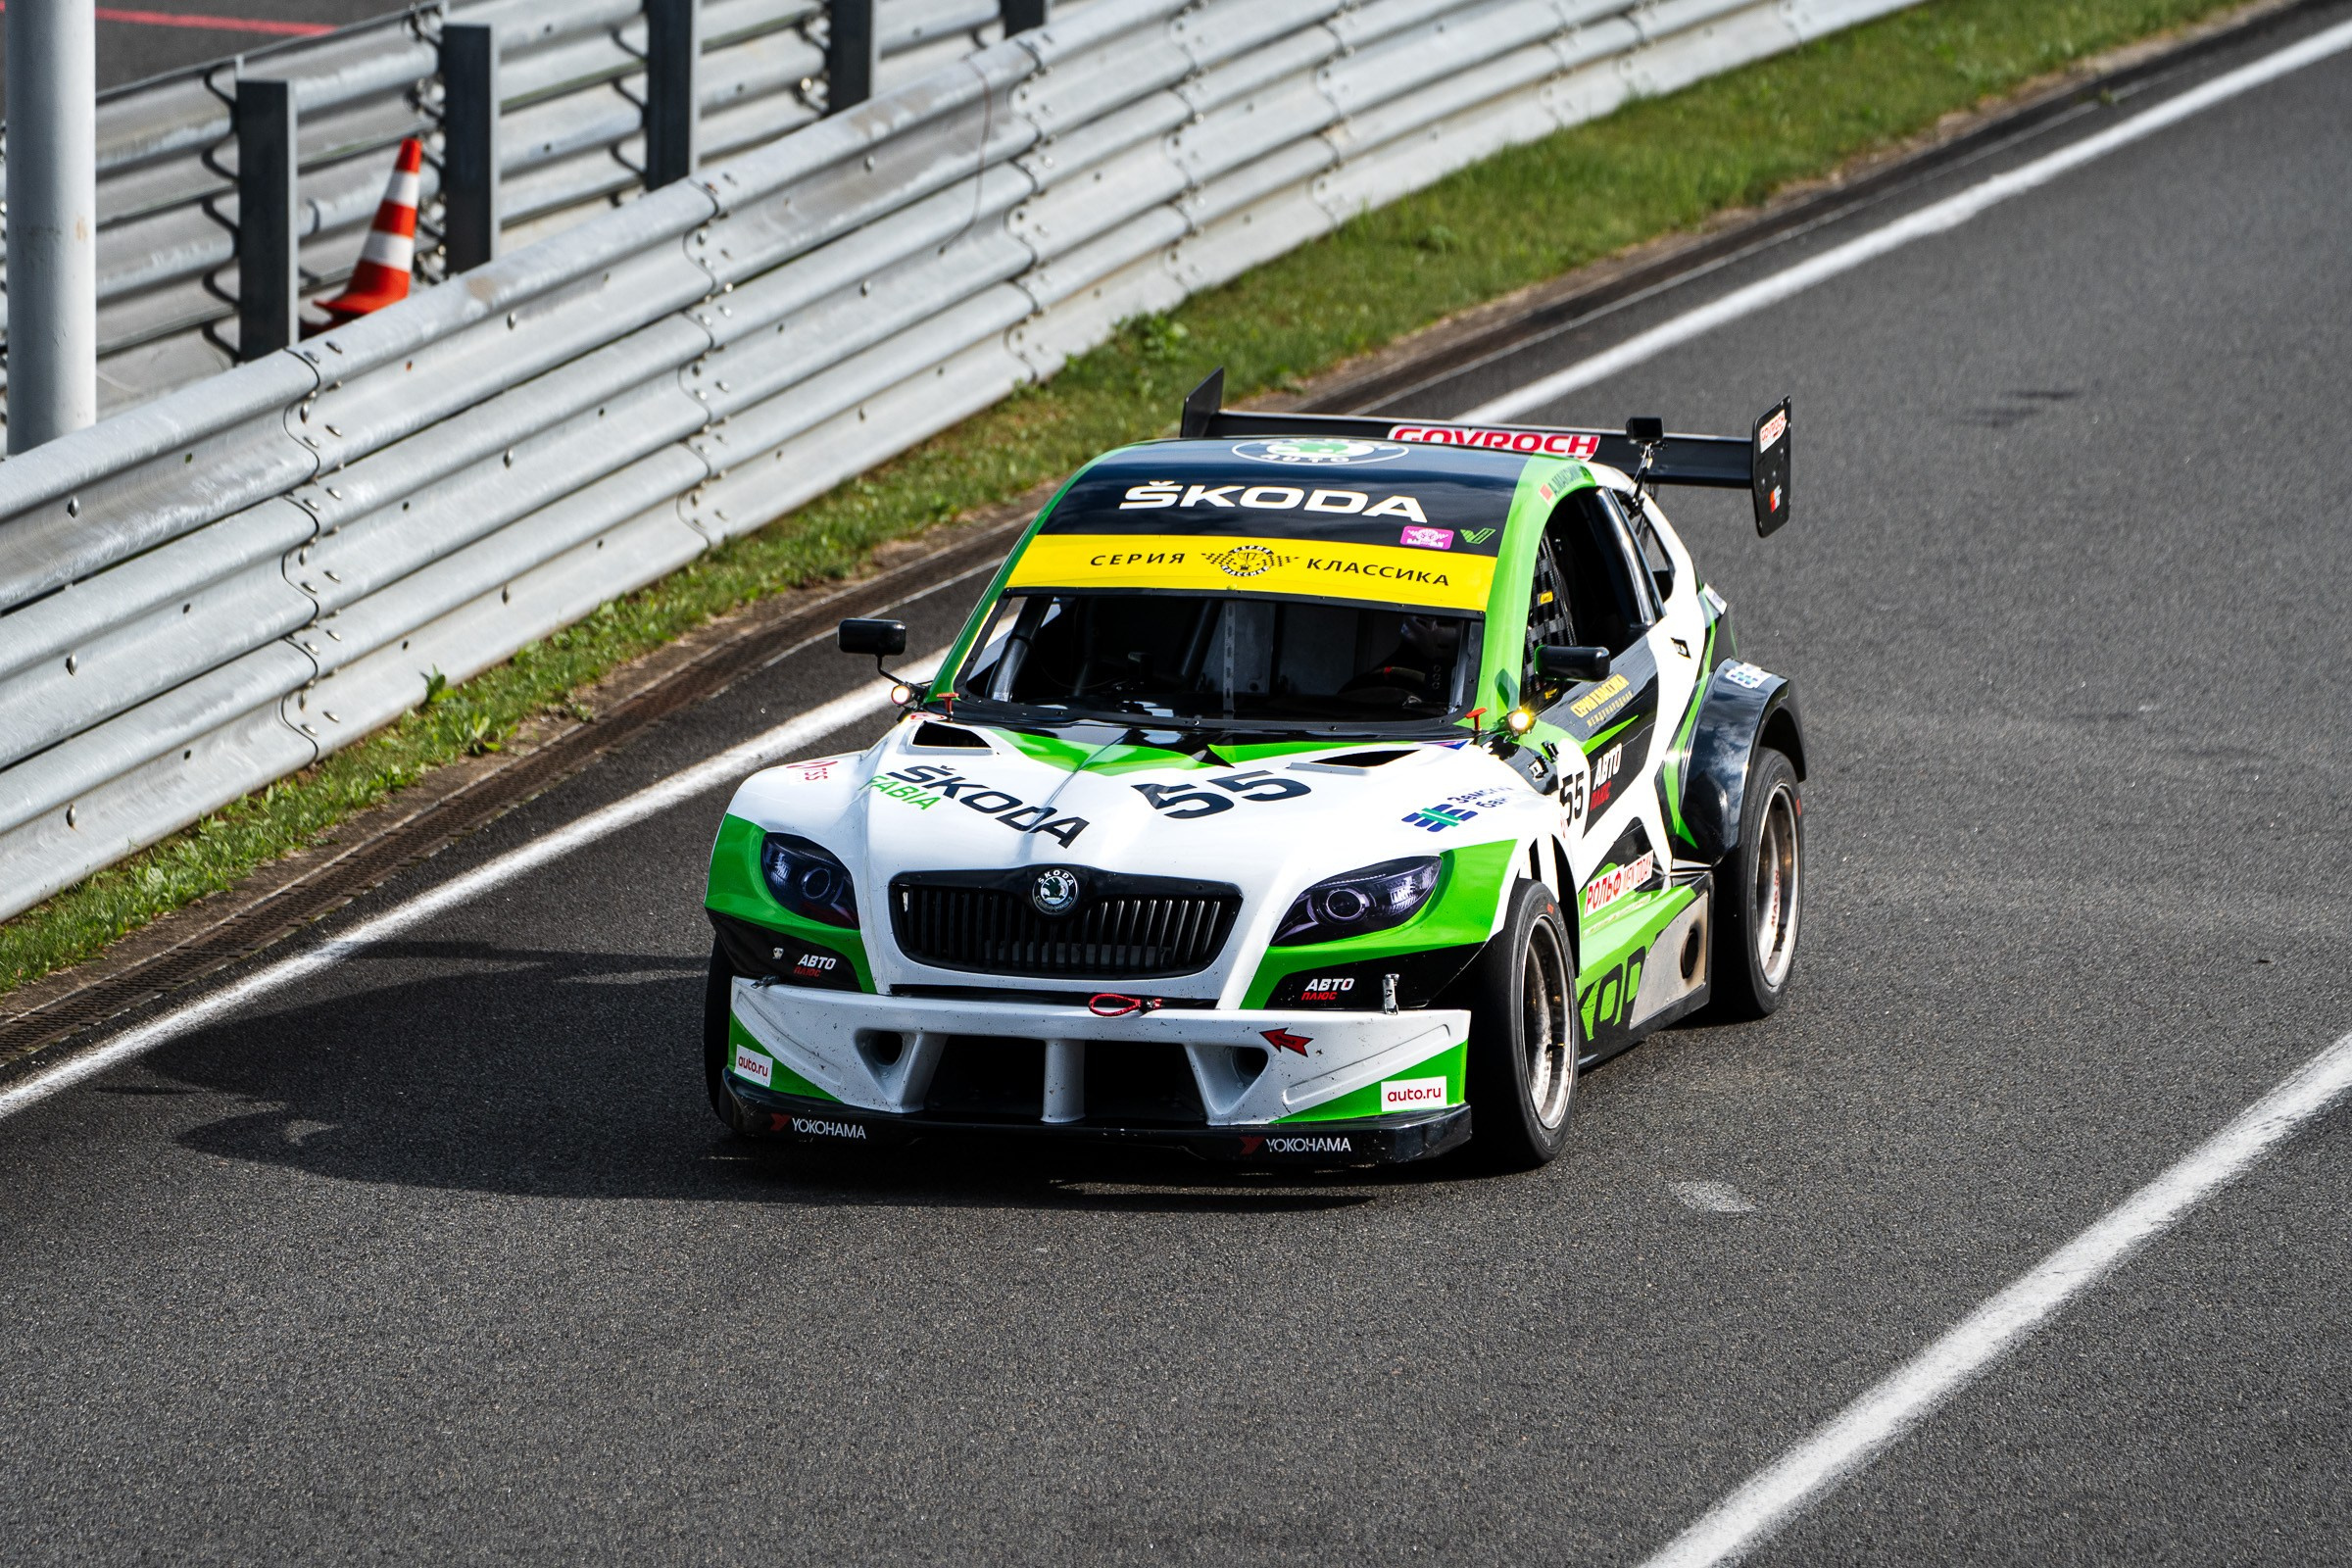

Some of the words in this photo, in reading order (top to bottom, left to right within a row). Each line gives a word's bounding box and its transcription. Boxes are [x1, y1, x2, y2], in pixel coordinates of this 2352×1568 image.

[1119, 480, 1428, 523] ŠKODA
[1090, 552, 1185, 566] СЕРИЯ
[1306, 559, 1449, 587] КЛАССИКА
[1592, 743, 1623, 791] АВТО
[860, 775, 942, 810] FABIA
[887, 764, 1090, 849] ŠKODA
[1131, 770, 1311, 819] 55
[1559, 771, 1585, 828] 55
[1586, 870, 1622, 914] РОЛЬФ
[794, 966, 821, 978] ПЛЮС
[798, 954, 837, 970] АВТО
[1300, 992, 1339, 1002] ПЛЮС
[1304, 978, 1355, 992] АВТО
[1577, 941, 1656, 1041] KOD
[738, 1055, 769, 1078] auto.ru
[1387, 1087, 1442, 1102] auto.ru
[791, 1117, 866, 1139] YOKOHAMA
[1265, 1137, 1352, 1152] YOKOHAMA
